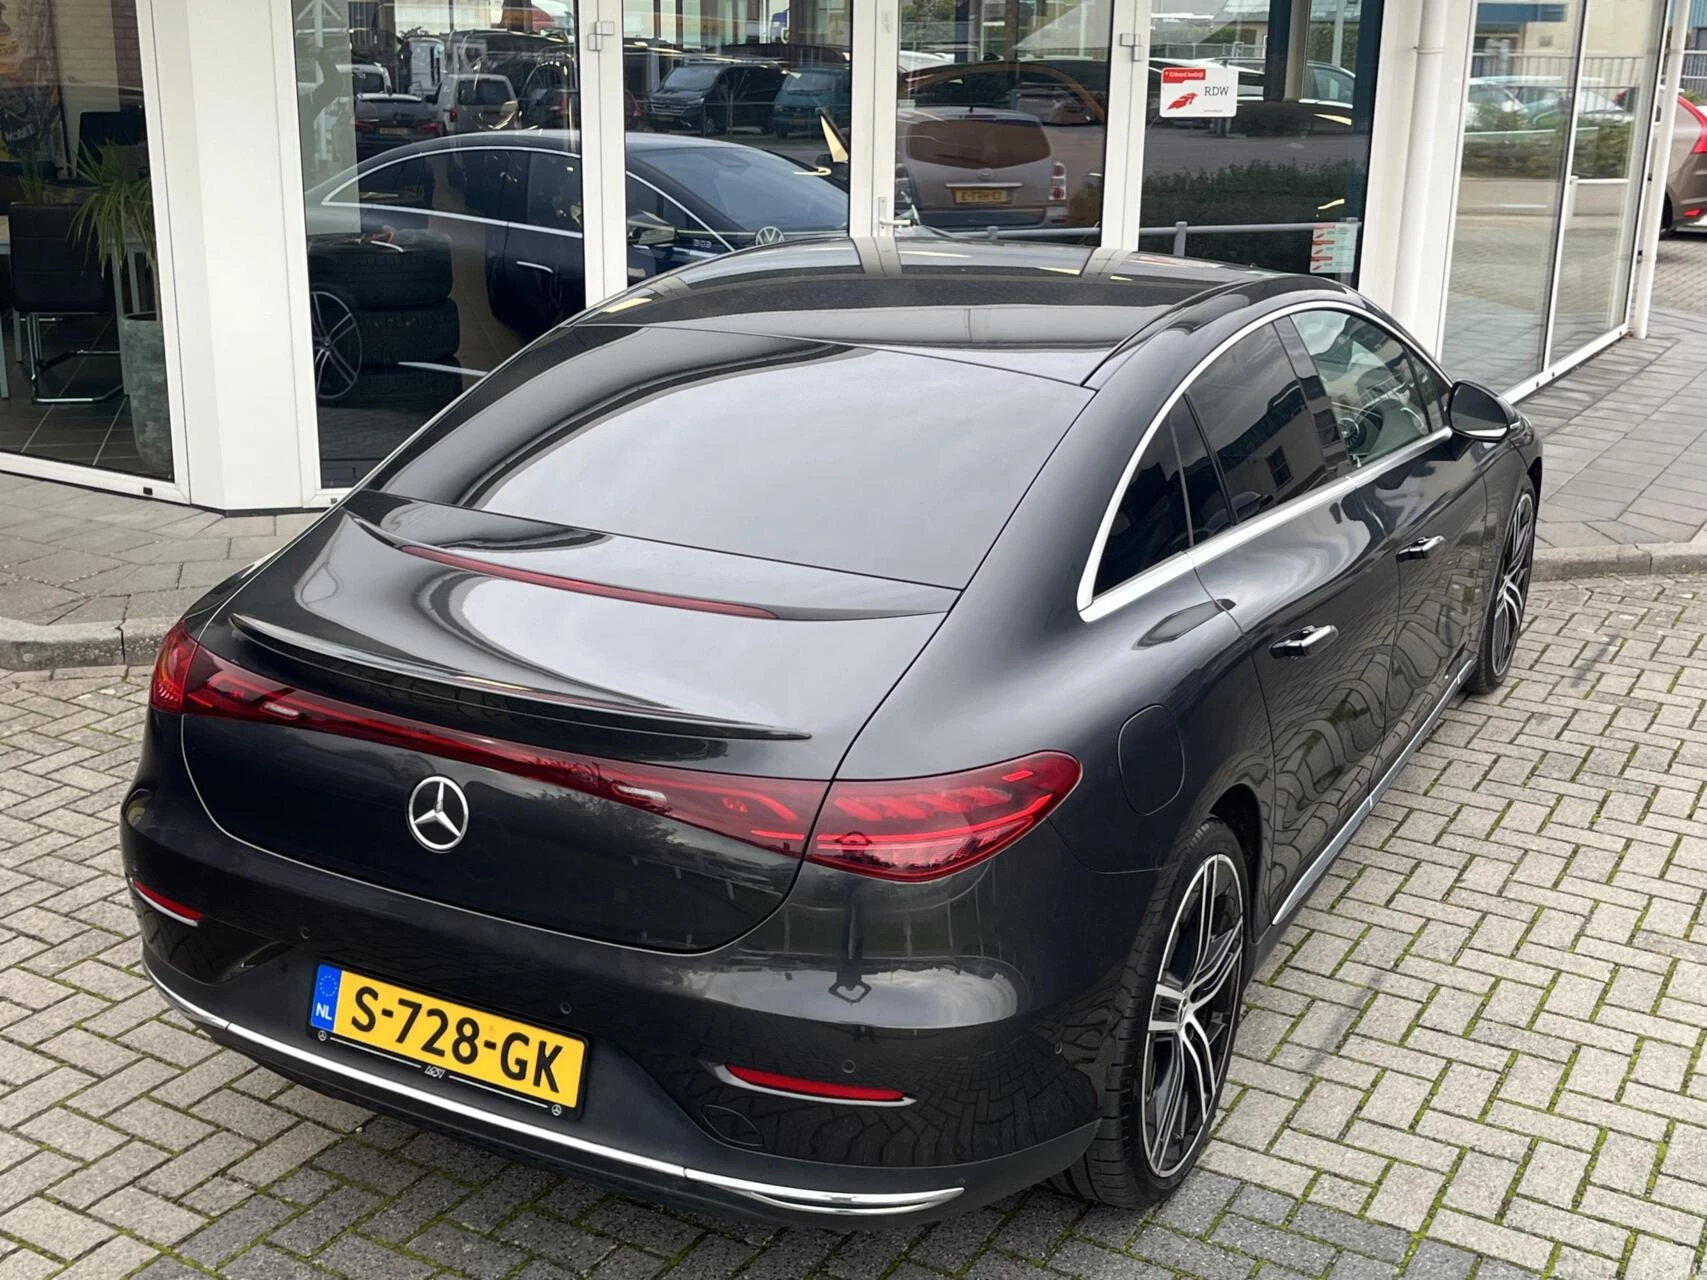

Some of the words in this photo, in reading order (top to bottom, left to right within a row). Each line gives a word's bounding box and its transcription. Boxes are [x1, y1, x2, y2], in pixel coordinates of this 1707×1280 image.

[1204, 86, 1229, 97] RDW
[315, 1002, 332, 1021] NL
[350, 985, 564, 1094] S-728-GK
